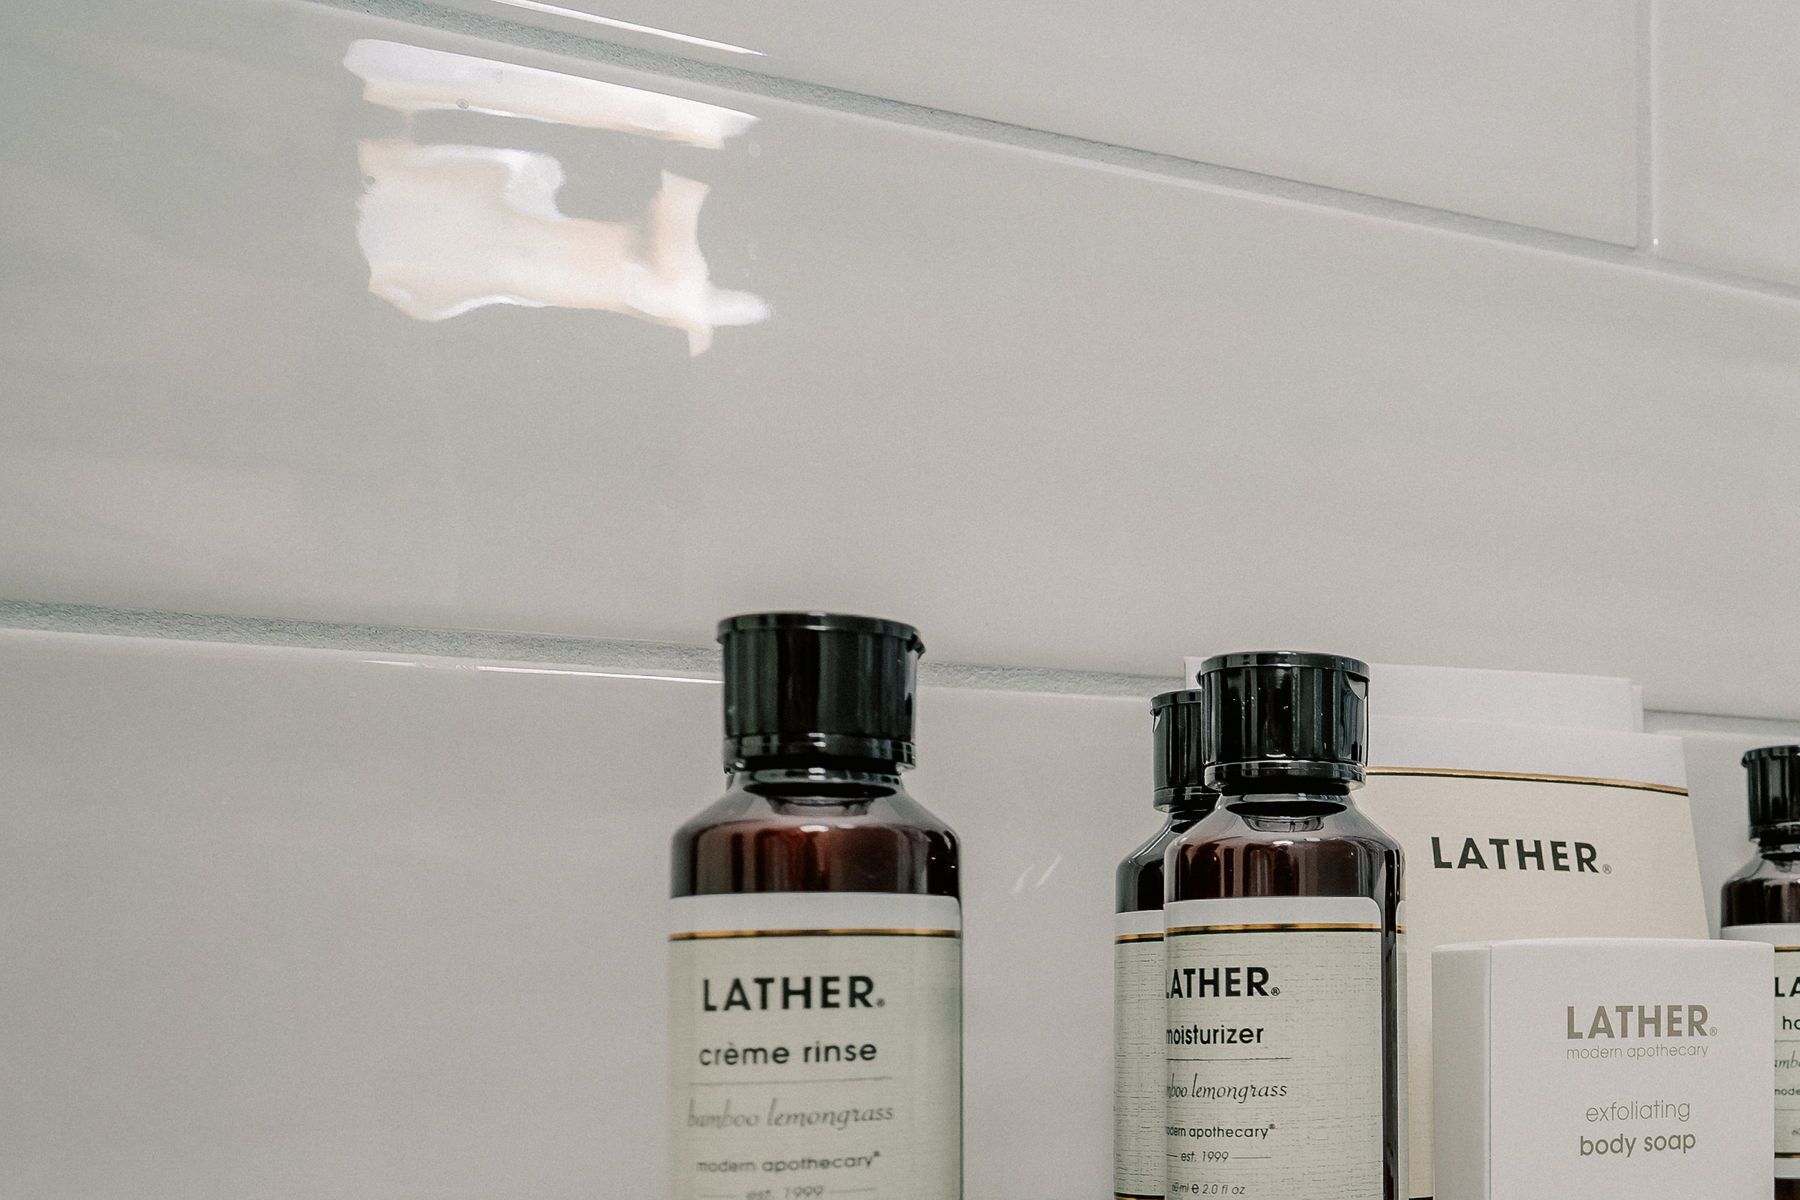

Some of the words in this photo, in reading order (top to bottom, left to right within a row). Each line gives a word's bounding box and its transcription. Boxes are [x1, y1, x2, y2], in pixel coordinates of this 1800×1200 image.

[699, 1042, 790, 1067] crème
[803, 1039, 878, 1063] rinse
[1566, 1046, 1623, 1060] modern
[1626, 1043, 1709, 1061] apothecary
[1191, 1072, 1288, 1104] lemongrass
[687, 1097, 760, 1129] bamboo
[766, 1096, 894, 1131] lemongrass
[1585, 1099, 1691, 1123] exfoliating
[1579, 1133, 1637, 1158] body
[1643, 1133, 1697, 1154] soap
[695, 1160, 757, 1173] modern
[1201, 1150, 1229, 1163] 1999
[784, 1184, 825, 1200] 1999
[1202, 1183, 1219, 1195] 2.0
[1221, 1183, 1229, 1195] fl
[1231, 1185, 1246, 1195] oz
